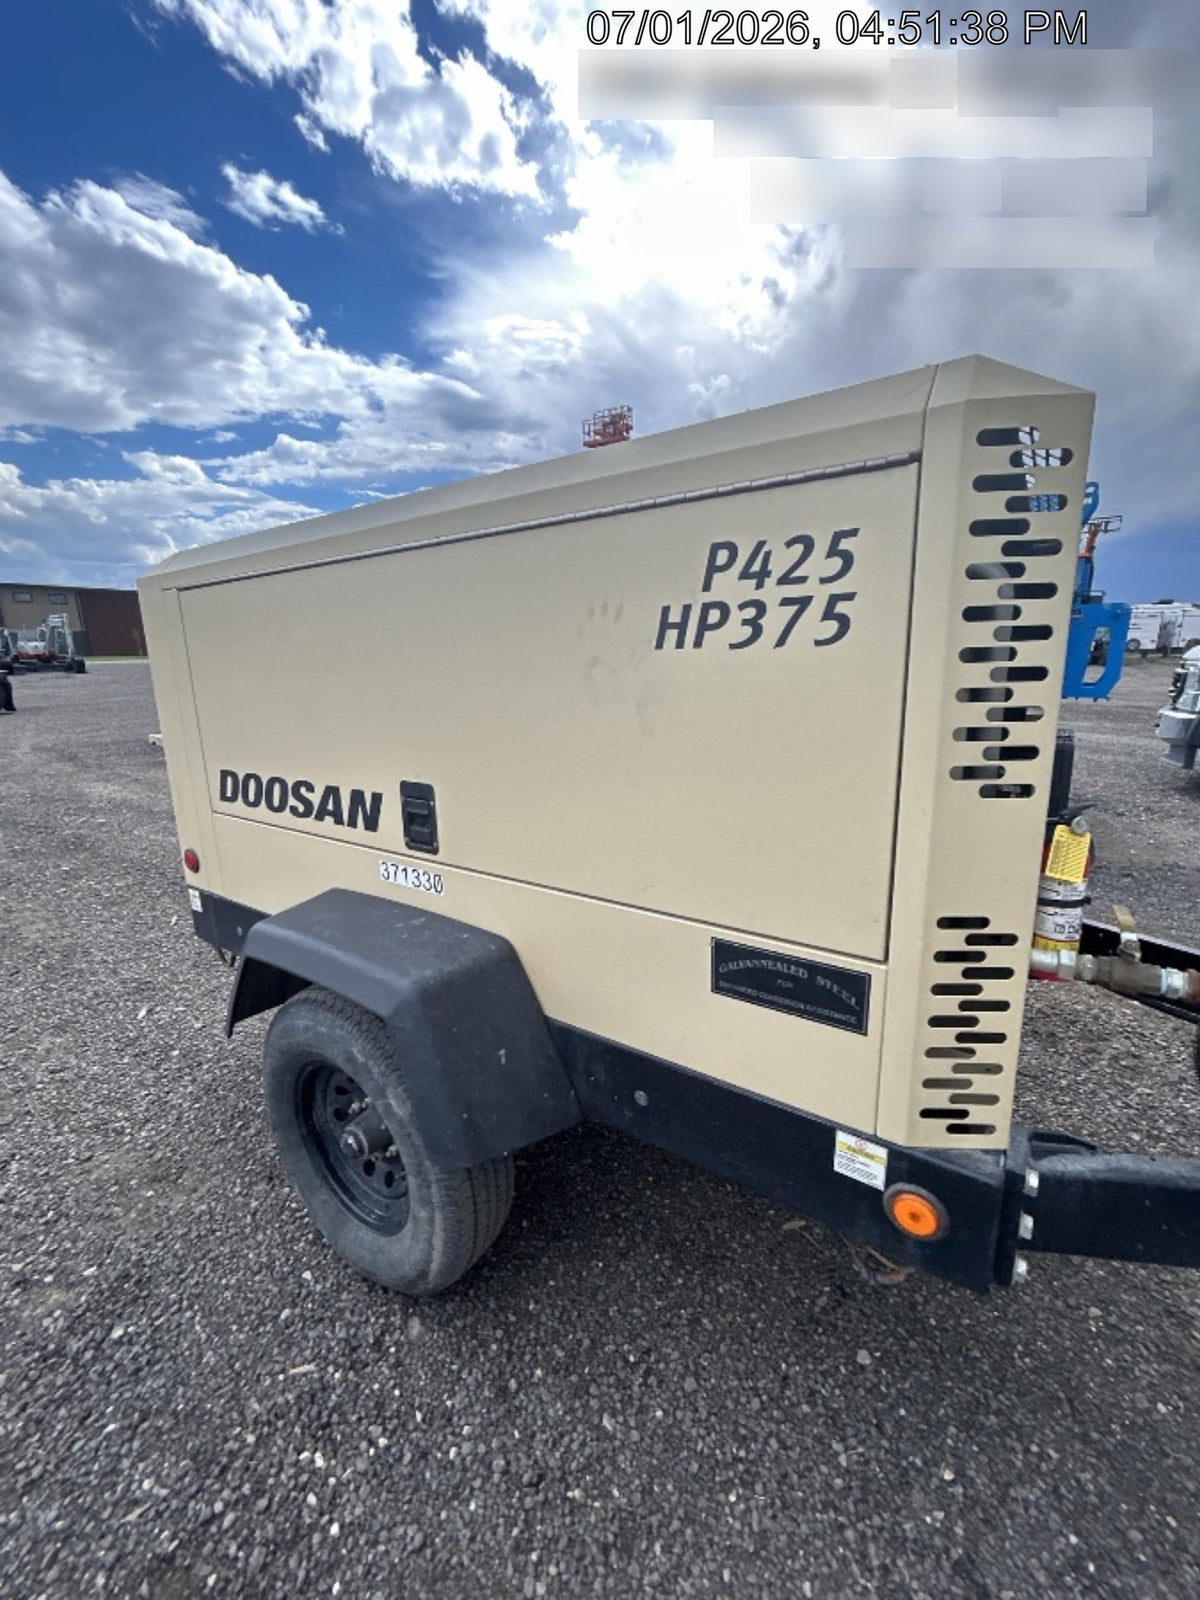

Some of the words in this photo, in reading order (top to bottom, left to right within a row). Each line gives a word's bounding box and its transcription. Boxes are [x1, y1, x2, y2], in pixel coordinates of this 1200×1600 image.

[701, 528, 861, 592] P425
[654, 591, 858, 650] HP375
[219, 769, 383, 832] DOOSAN
[381, 861, 444, 894] 371330
[815, 975, 860, 1011] STEEL
